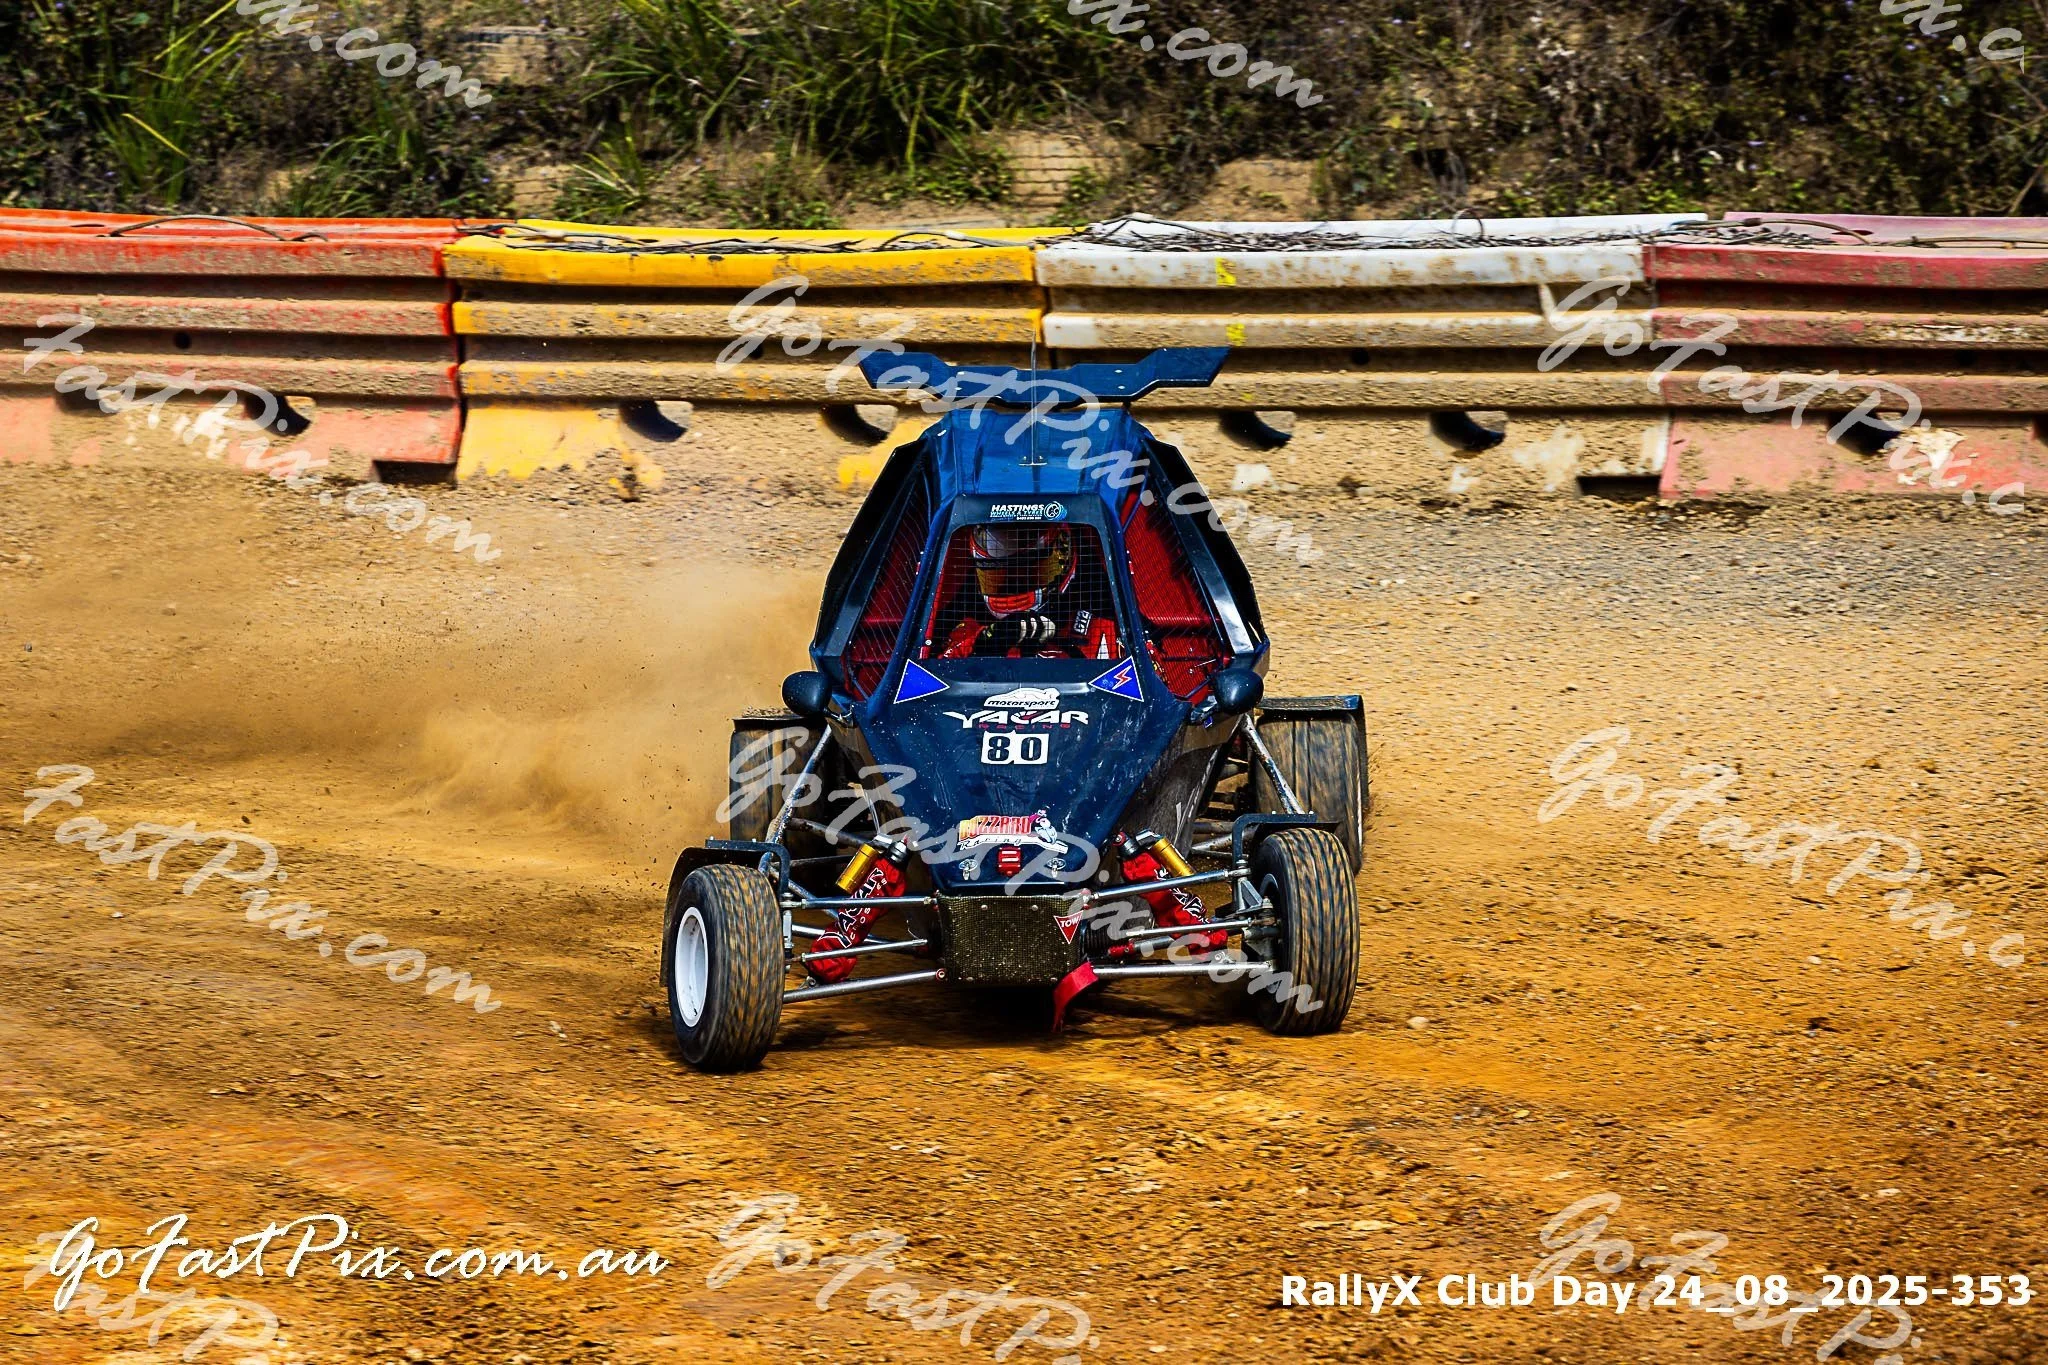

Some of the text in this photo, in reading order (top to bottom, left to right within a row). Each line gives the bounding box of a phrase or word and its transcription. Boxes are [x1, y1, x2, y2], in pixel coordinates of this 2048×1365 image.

[990, 504, 1045, 512] HASTINGS
[987, 700, 1057, 708] motorsport
[943, 710, 1089, 729] YACAR
[978, 722, 1071, 730] RACING
[987, 735, 1042, 762] 80
[1060, 915, 1080, 928] TOW
